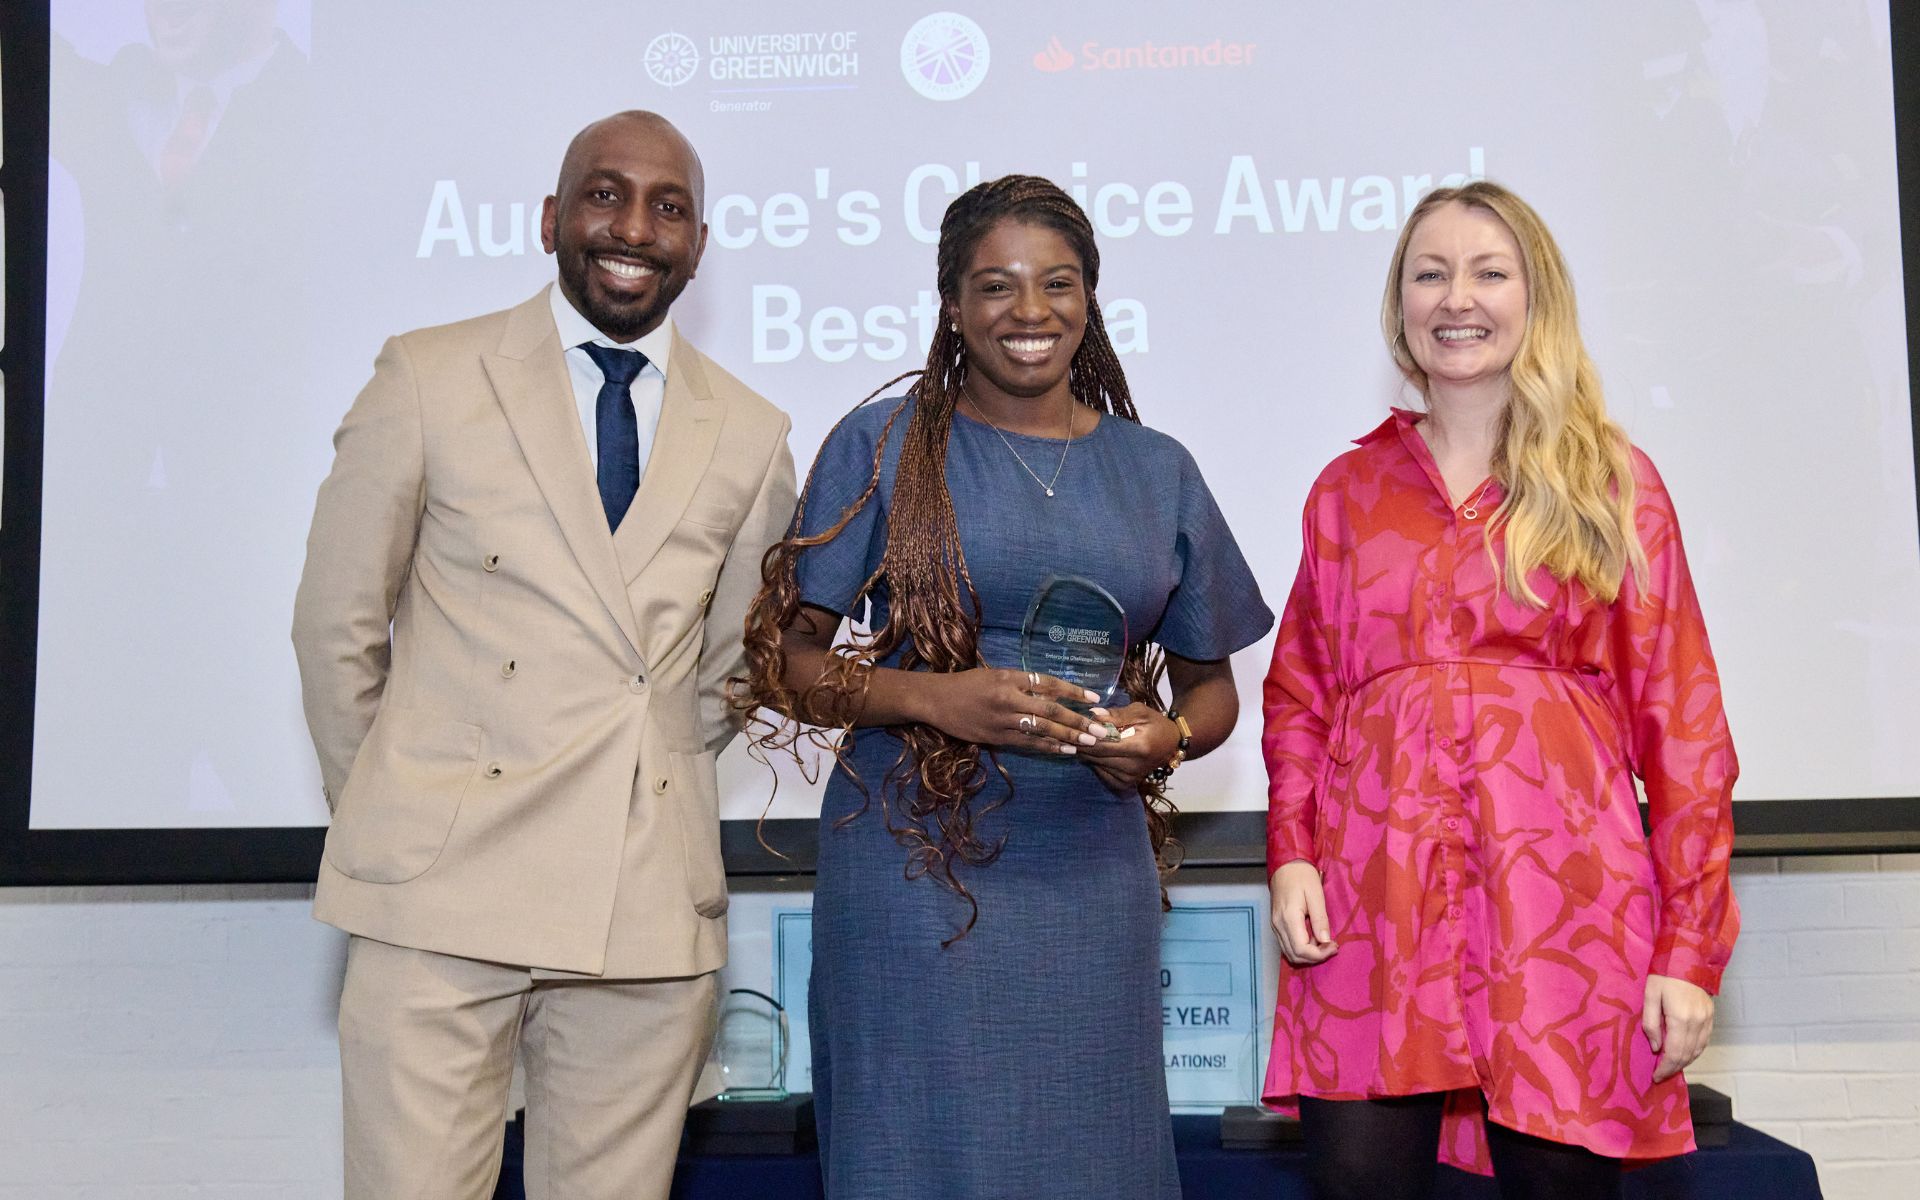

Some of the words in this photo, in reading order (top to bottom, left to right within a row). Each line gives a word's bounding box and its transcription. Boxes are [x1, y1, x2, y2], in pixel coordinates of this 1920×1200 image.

[709, 33, 826, 56] UNIVERSITY
[831, 31, 857, 51] OF
[1082, 39, 1257, 70] Santander
[709, 53, 859, 80] GREENWICH
[709, 99, 772, 113] Generator
[416, 167, 881, 258] Auce's
[904, 161, 1193, 244] Cice
[752, 284, 940, 363] Best
[1066, 634, 1110, 645] GREENWICH
[1067, 627, 1101, 637] UNIVERSITY
[1176, 1007, 1230, 1026] YEAR
